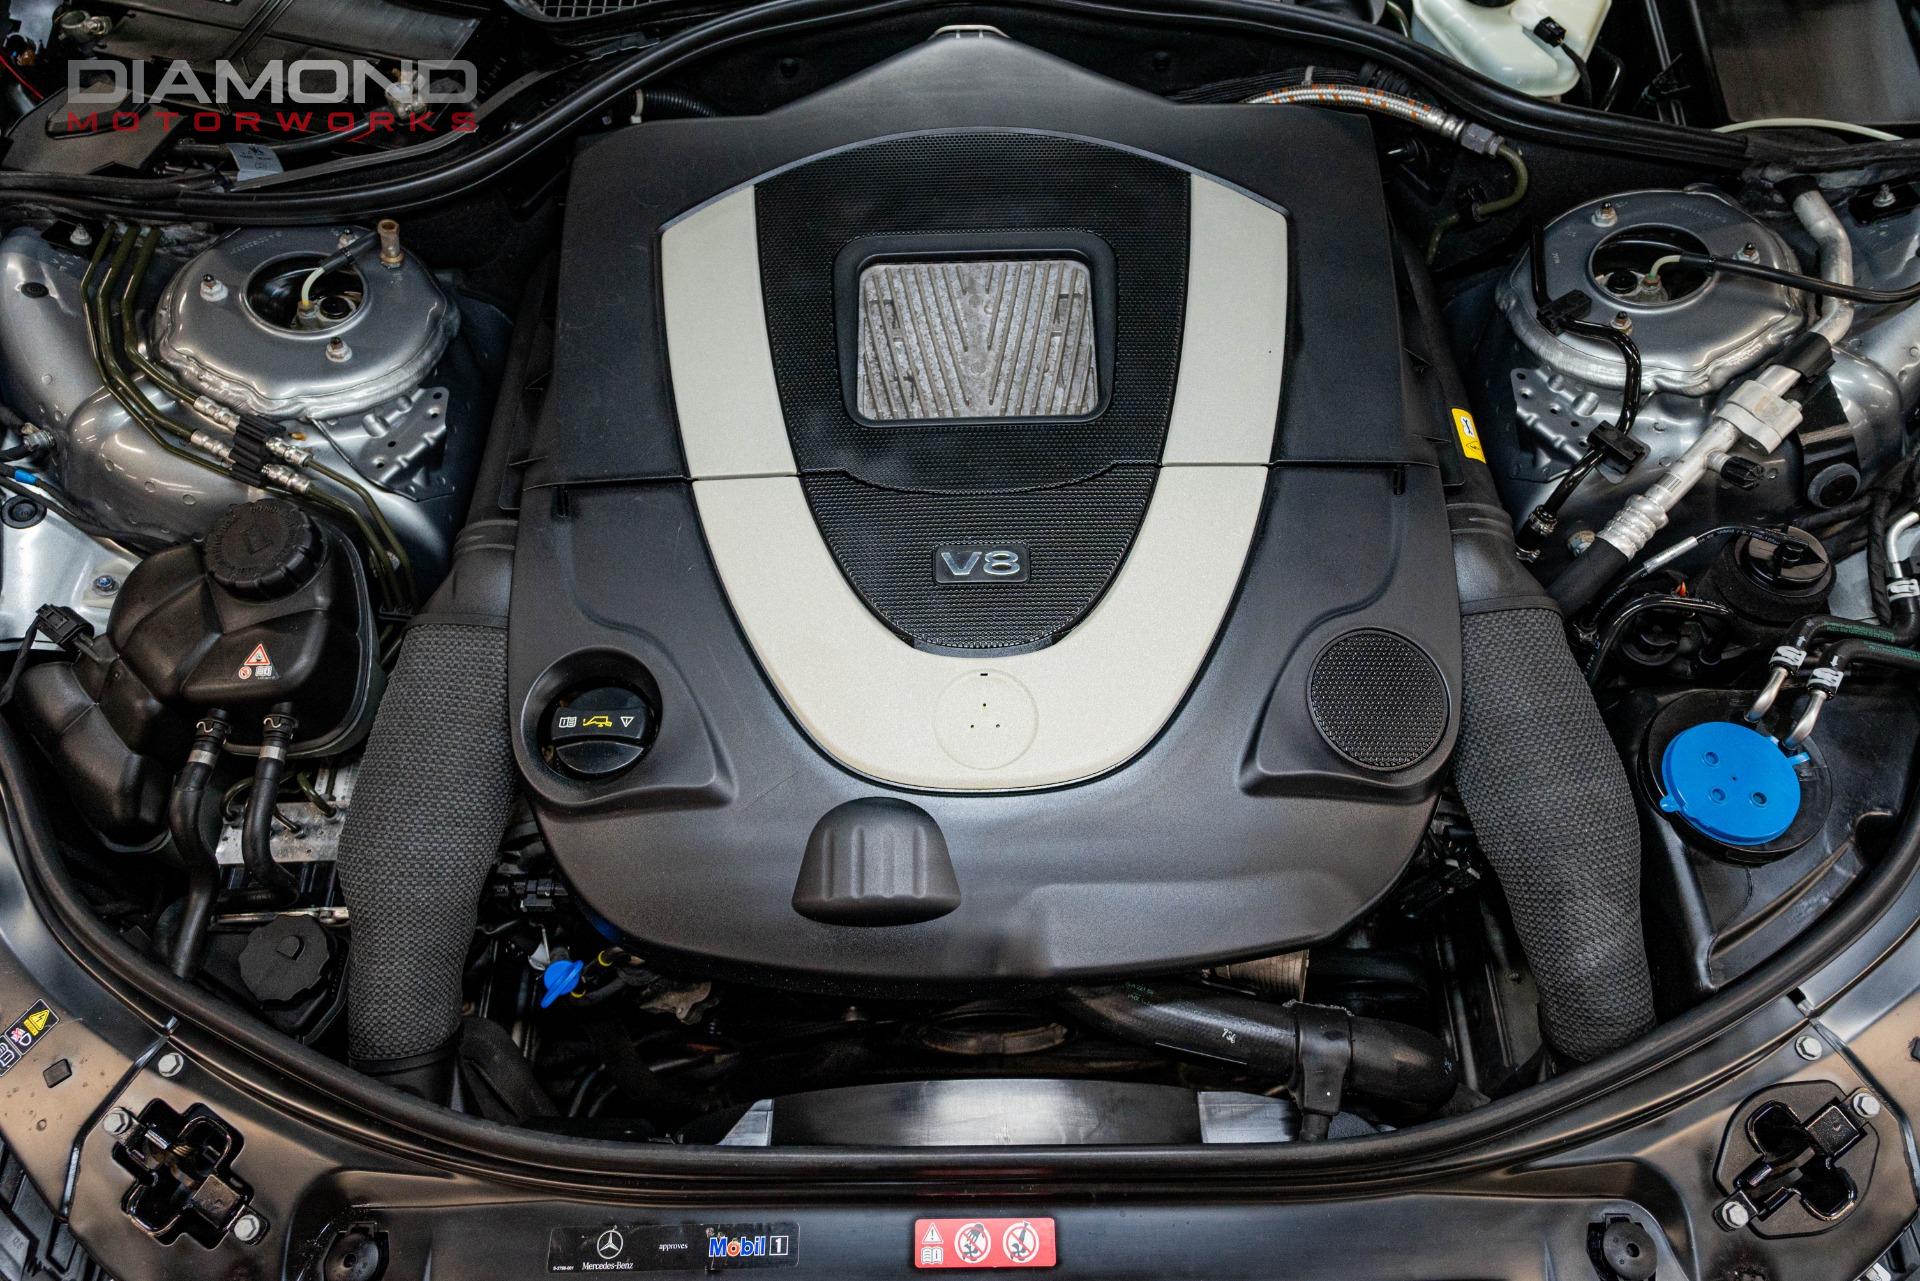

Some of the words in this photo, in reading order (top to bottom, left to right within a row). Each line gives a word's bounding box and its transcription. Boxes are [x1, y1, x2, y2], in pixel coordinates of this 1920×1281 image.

[940, 550, 1020, 576] V8
[658, 1241, 689, 1252] approves
[708, 1235, 767, 1258] Mobil
[582, 1261, 634, 1271] Mercedes-Benz
